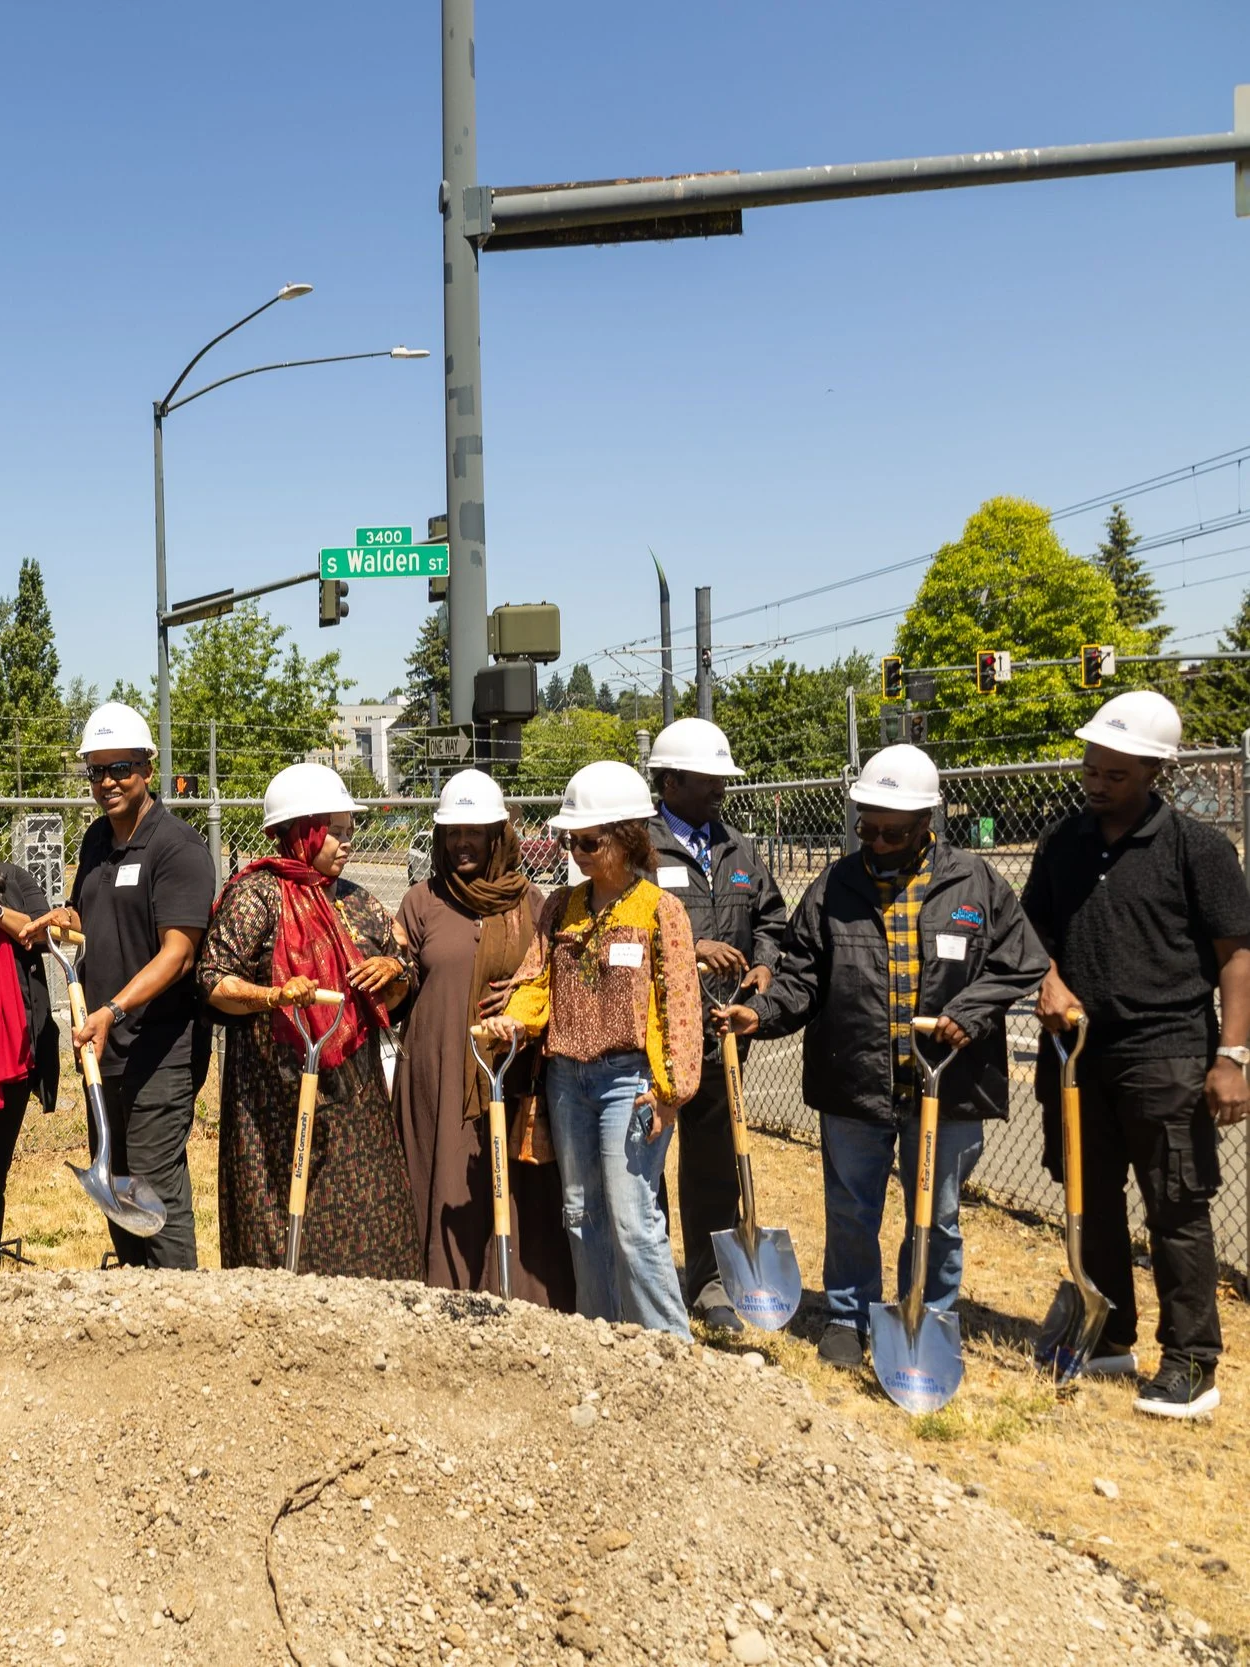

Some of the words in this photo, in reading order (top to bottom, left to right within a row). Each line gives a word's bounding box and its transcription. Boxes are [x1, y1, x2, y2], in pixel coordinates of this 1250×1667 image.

[365, 530, 403, 544] 3400
[327, 557, 338, 573] S
[346, 549, 420, 573] Walden
[428, 557, 444, 571] ST
[431, 740, 443, 756] ONE
[445, 738, 458, 754] WAY
[298, 1112, 309, 1152] Community
[295, 1153, 303, 1179] African
